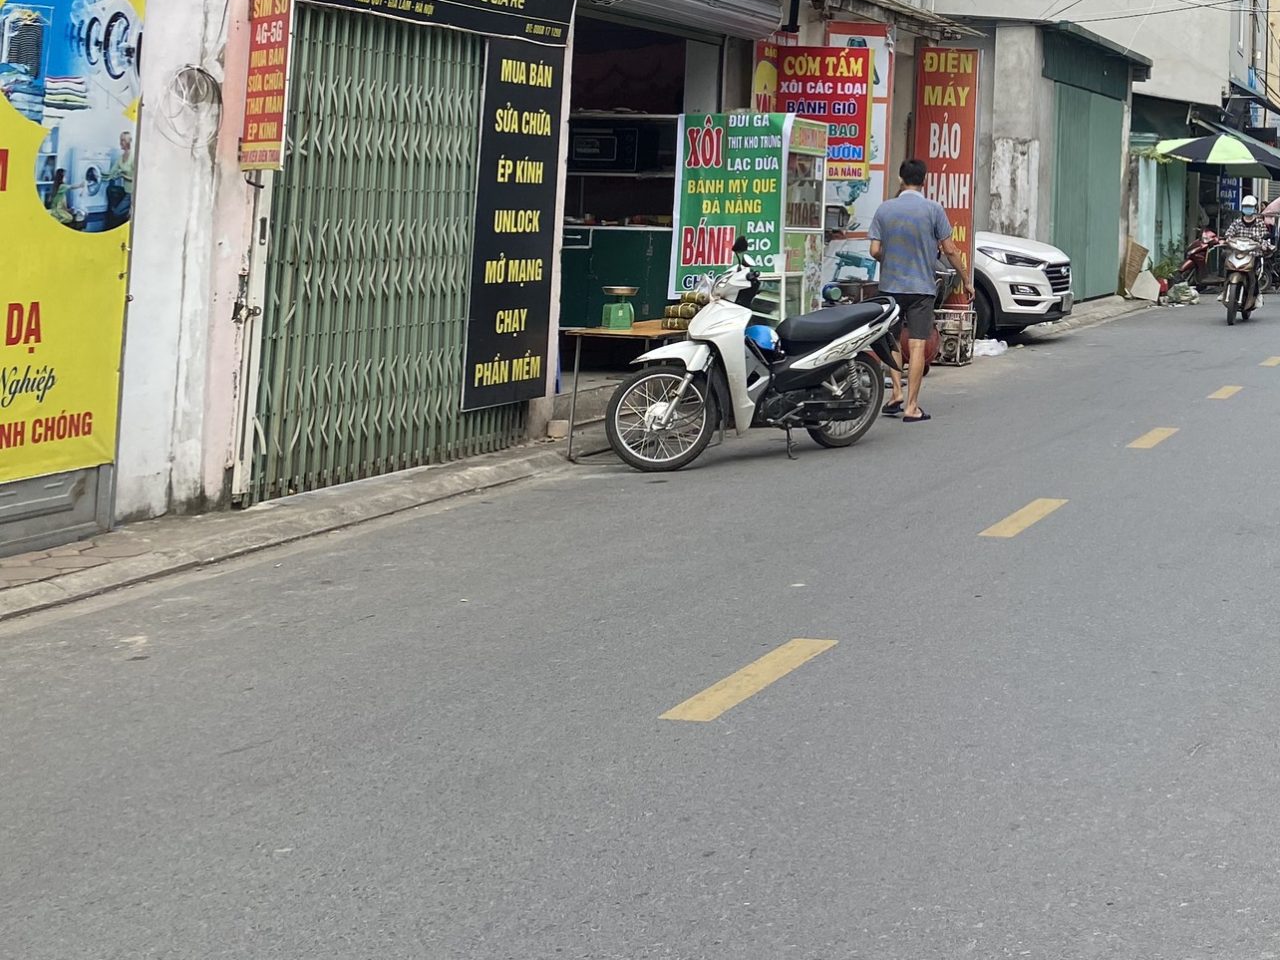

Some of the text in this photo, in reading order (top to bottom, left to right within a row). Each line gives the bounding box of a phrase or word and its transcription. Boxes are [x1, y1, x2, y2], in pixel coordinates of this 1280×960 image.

[255, 20, 283, 45] 4G-5G
[501, 59, 553, 88] MUA BÁN
[783, 48, 864, 77] CƠM TẤM
[924, 48, 973, 77] ĐIỆN
[780, 79, 867, 97] XÔI CÁC LOẠI
[924, 80, 970, 107] MÁY
[495, 101, 551, 137] SỬA CHỮA
[828, 124, 858, 138] BAO
[685, 114, 723, 169] XÔI
[728, 135, 743, 152] THỊT
[744, 136, 759, 149] KHO
[929, 112, 961, 160] BẢO
[497, 155, 544, 184] ÉP KÍNH
[727, 157, 751, 174] LẠC
[687, 176, 724, 194] BÁNH
[752, 178, 777, 195] QUE
[922, 164, 970, 209] HÁNH
[494, 209, 541, 233] UNLOCK
[681, 217, 736, 267] BÁNH
[485, 256, 543, 287] MỞ MẠNG
[5, 301, 42, 354] DẠ
[495, 308, 528, 338] CHẠY
[474, 349, 542, 388] PHẦN MỀM
[0, 365, 57, 409] Nghiệp
[31, 410, 93, 444] CHÓNG
